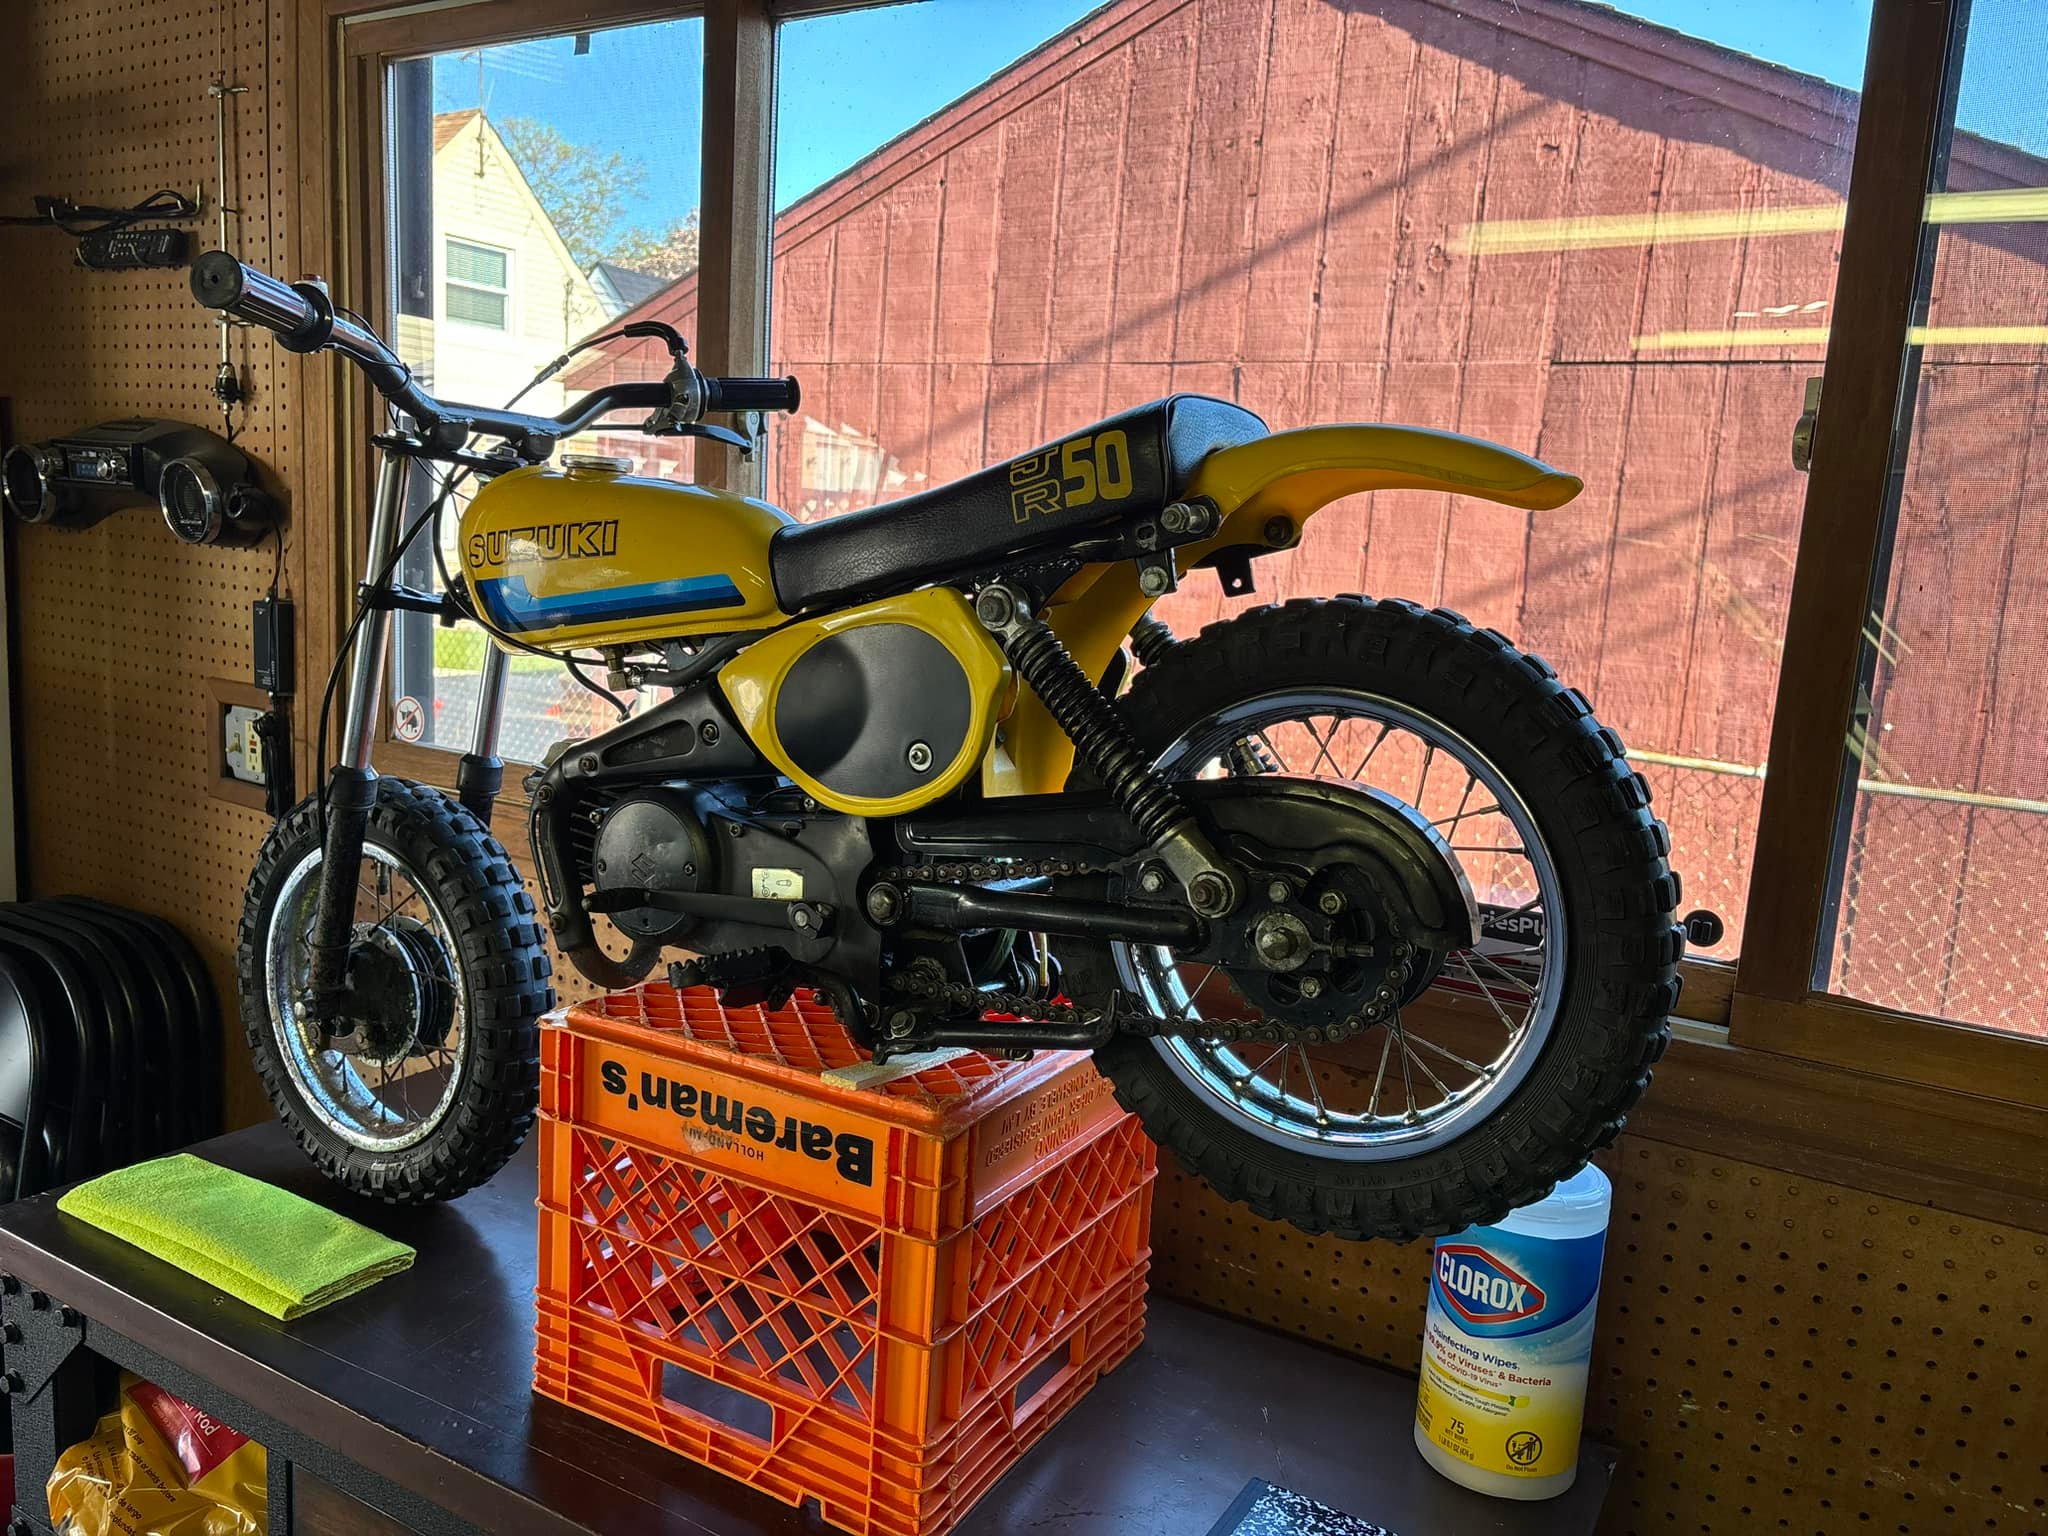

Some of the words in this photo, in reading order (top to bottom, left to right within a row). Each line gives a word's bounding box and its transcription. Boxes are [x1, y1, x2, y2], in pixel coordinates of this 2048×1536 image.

[1480, 910, 1545, 937] riesPl
[601, 1060, 874, 1187] Bareman's
[1440, 1251, 1527, 1314] CLOROX
[1433, 1323, 1480, 1361] Disinfecting
[1447, 1351, 1457, 1362] of
[1498, 1371, 1506, 1381] &
[1508, 1373, 1552, 1387] Bacteria
[1447, 1361, 1479, 1381] COVID-19
[194, 1411, 221, 1437] Rod
[1450, 1417, 1465, 1435] 75
